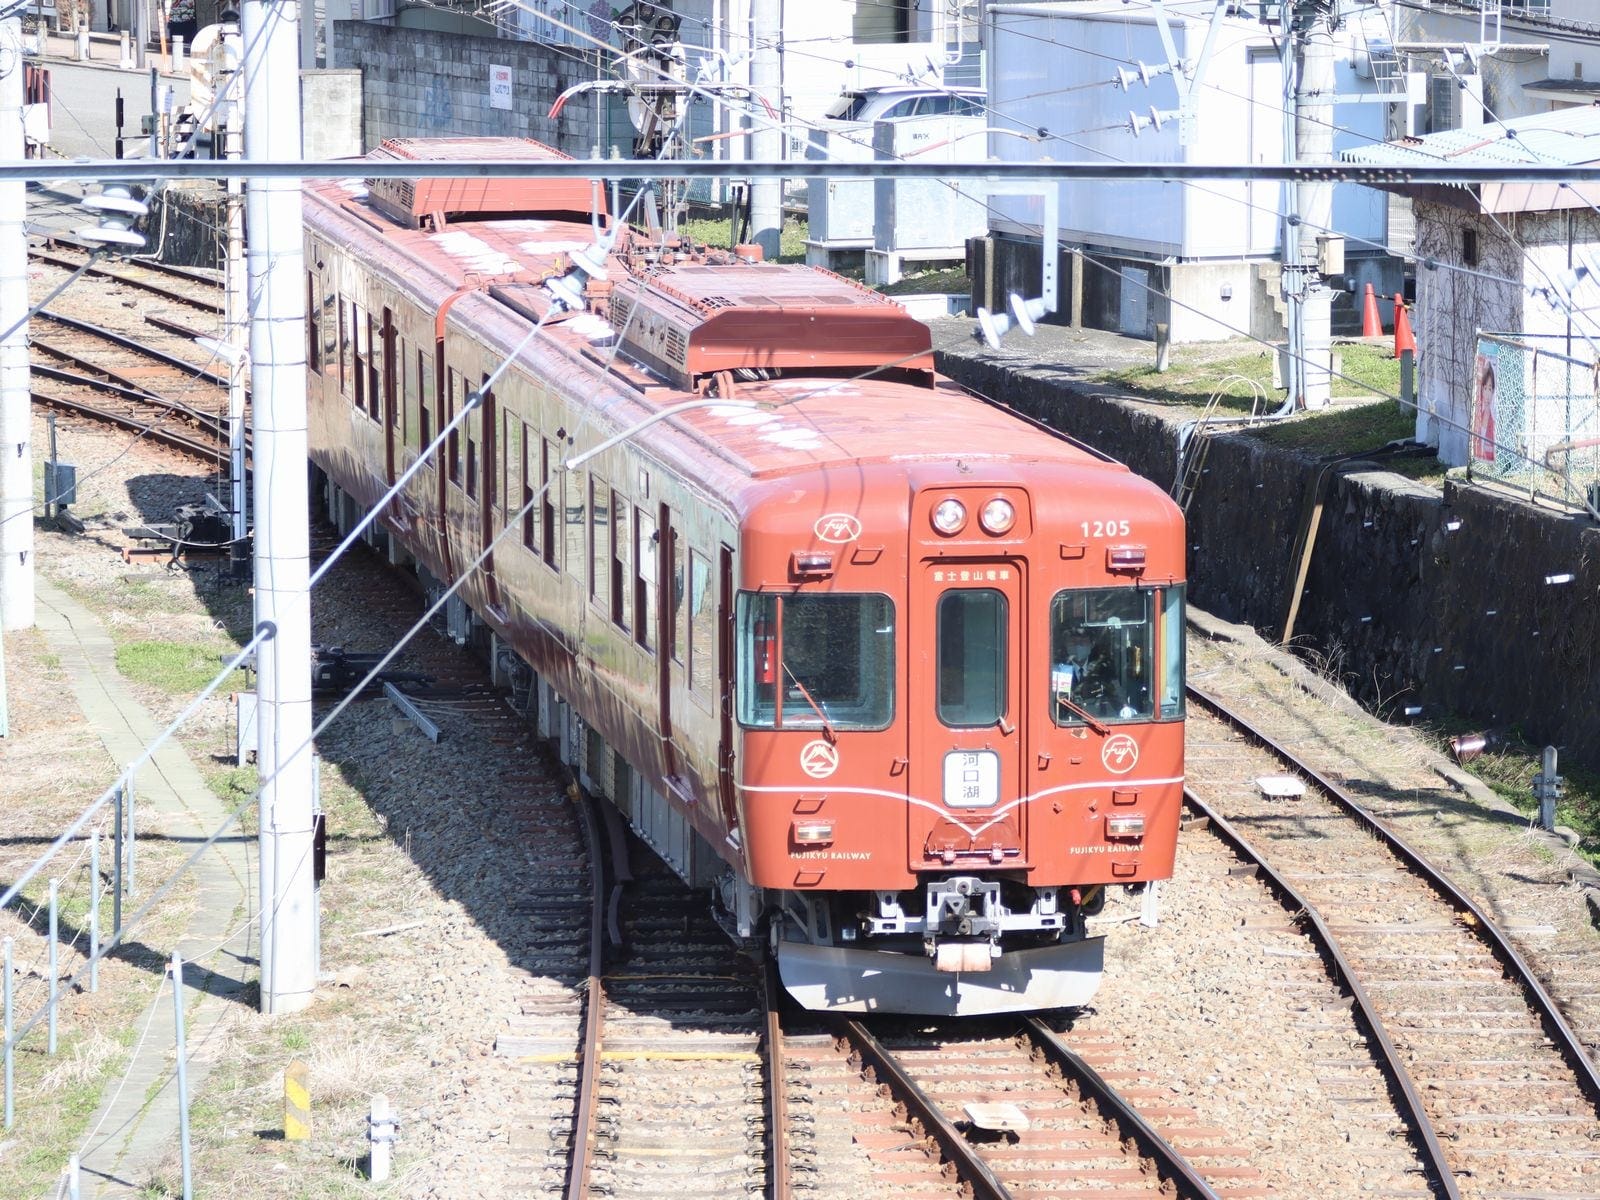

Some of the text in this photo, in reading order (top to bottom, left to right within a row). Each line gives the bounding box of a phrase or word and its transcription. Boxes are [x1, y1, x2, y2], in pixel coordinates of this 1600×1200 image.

[1080, 520, 1130, 538] 1205
[933, 570, 1010, 582] 富士登山電車
[962, 752, 980, 799] 河口湖
[1070, 844, 1145, 855] FUJIKYU RAILWAY
[790, 852, 872, 860] FUJIKYU RAILWAY
